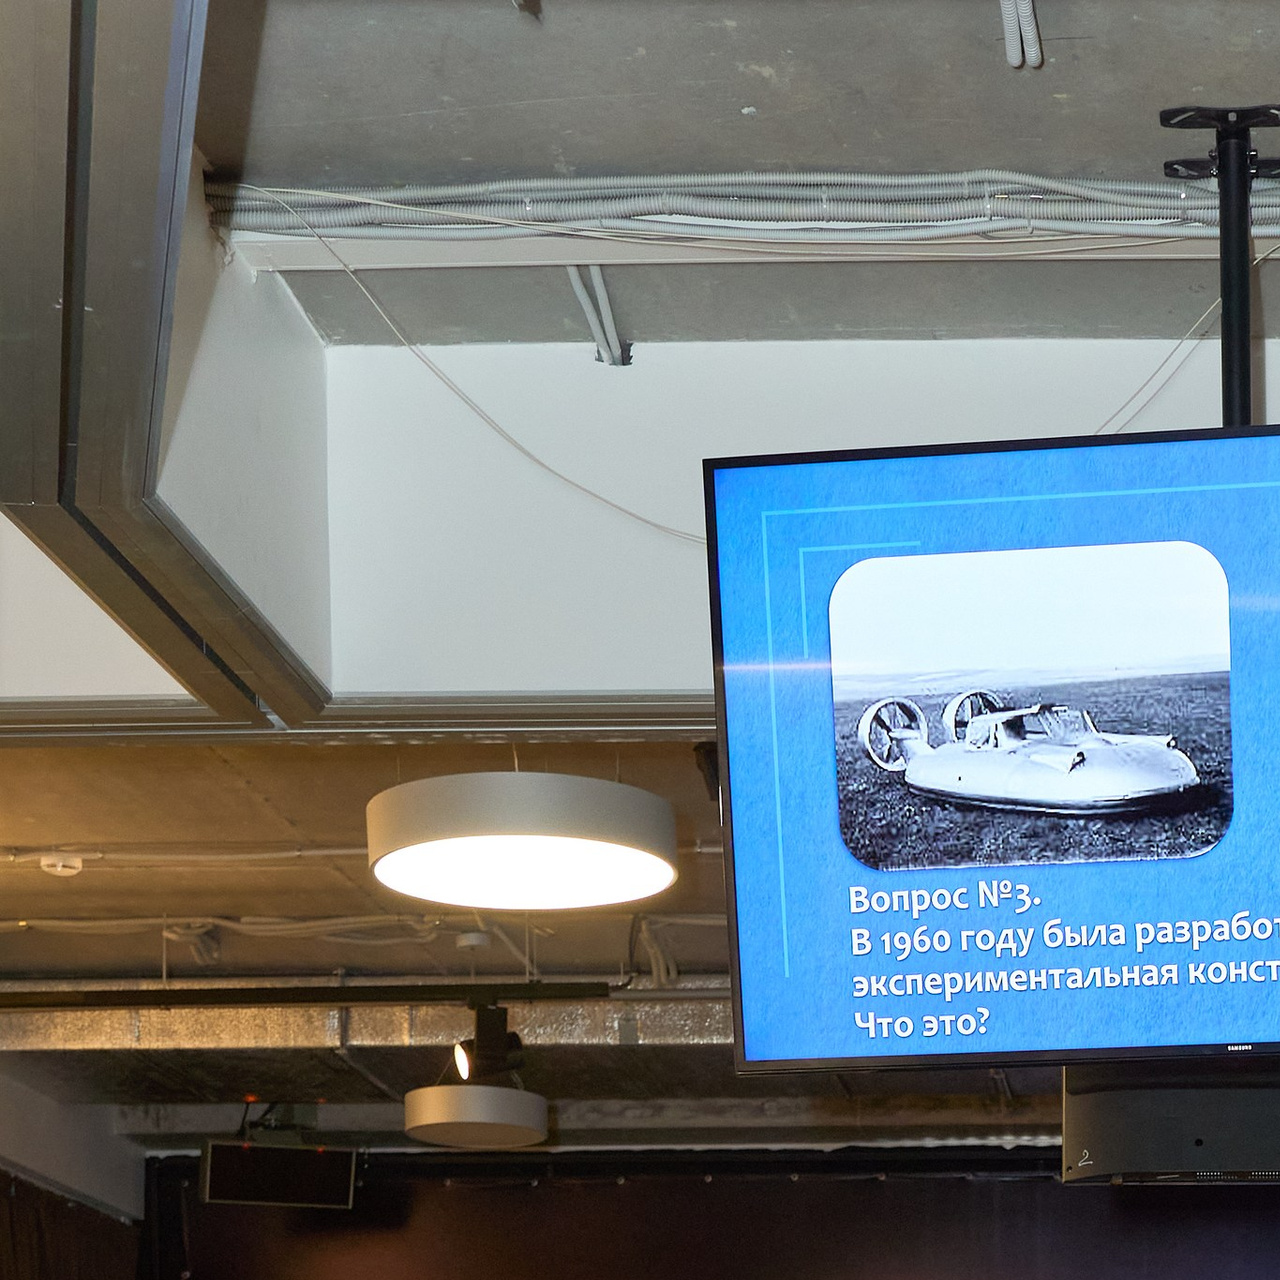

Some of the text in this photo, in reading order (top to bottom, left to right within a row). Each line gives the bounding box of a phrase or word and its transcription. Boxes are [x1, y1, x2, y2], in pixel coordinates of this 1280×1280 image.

[848, 879, 1042, 919] Вопрос №3.
[851, 928, 872, 956] В
[880, 925, 951, 961] 1960
[960, 926, 1035, 957] году
[1043, 918, 1126, 948] была
[852, 963, 1178, 1002] экспериментальная
[854, 1007, 990, 1038] Что это?
[1078, 1149, 1094, 1167] 2
